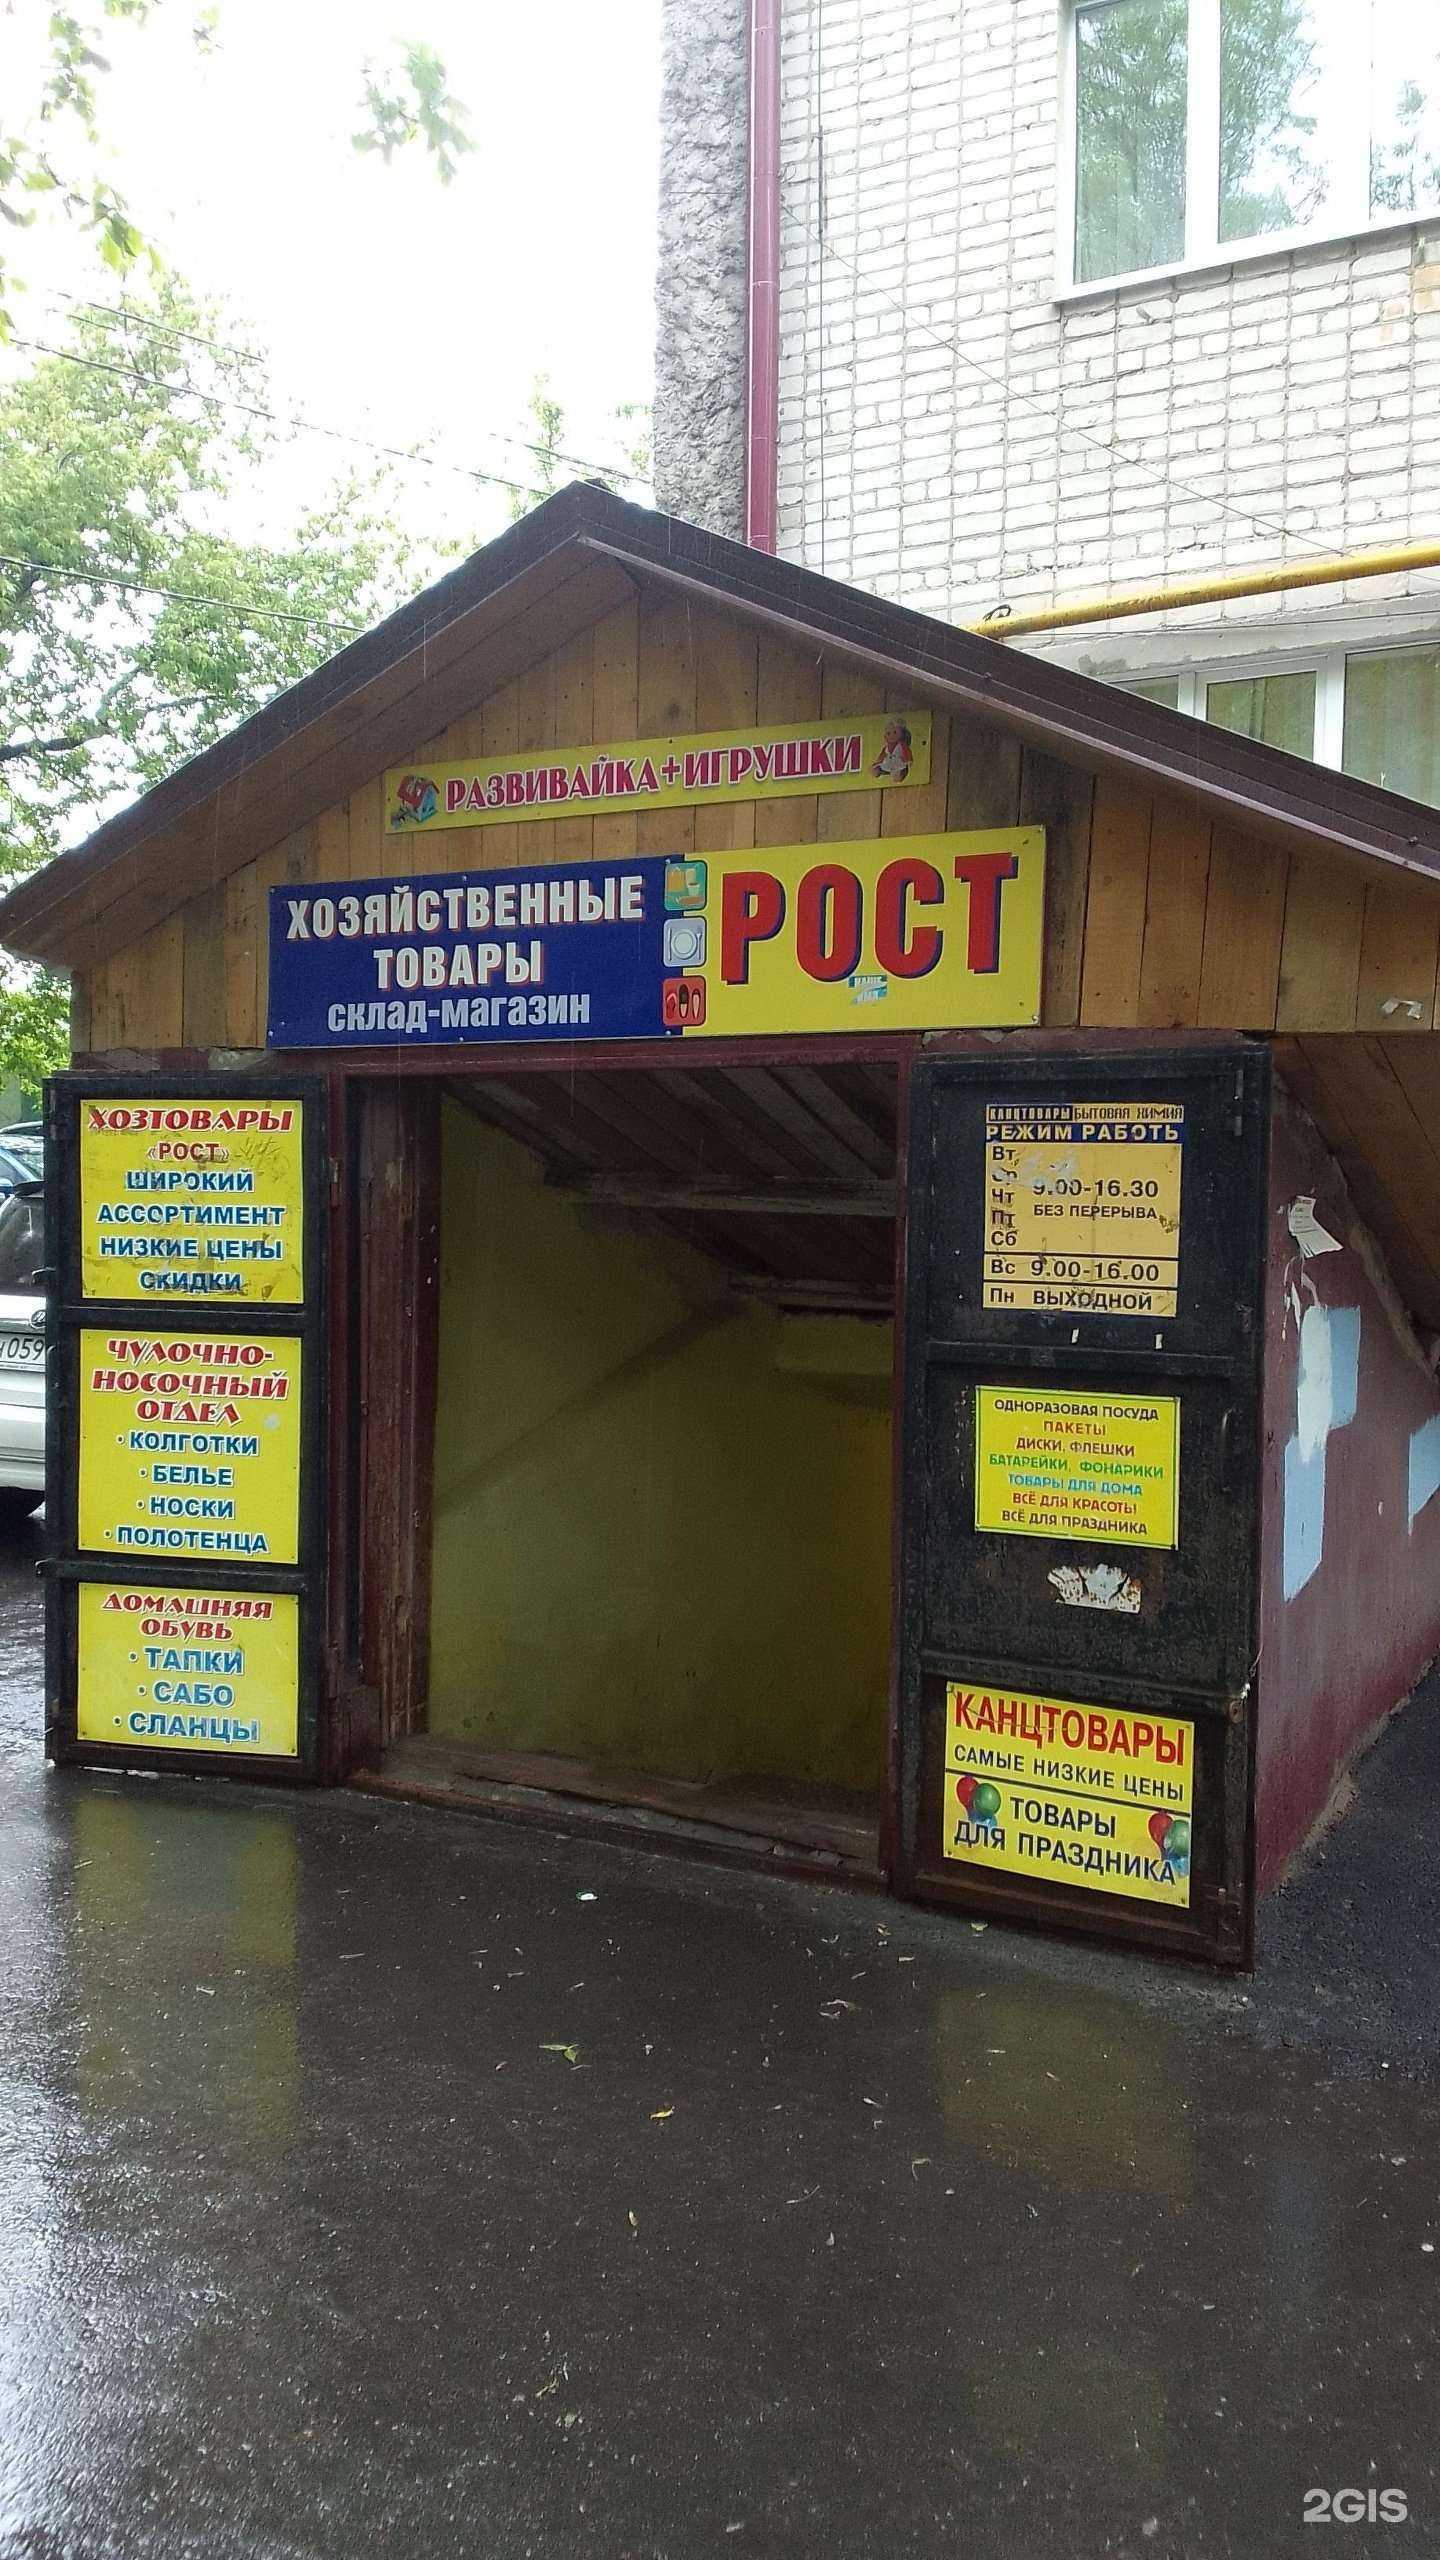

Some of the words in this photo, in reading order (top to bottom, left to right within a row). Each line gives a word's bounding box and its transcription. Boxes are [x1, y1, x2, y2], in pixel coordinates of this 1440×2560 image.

[445, 735, 863, 812] РАЗВИВАЙКА+ИГРУШКИ
[286, 875, 646, 940] ХОЗЯЙСТВЕННЫЕ
[720, 852, 1019, 986] РОСТ
[373, 940, 543, 991] ТОВАРЫ
[327, 994, 590, 1034] склад-магазин
[89, 1109, 293, 1131] ХОЗТОВАРЫ
[1074, 1107, 1130, 1121] БЫТОВАЯ
[1136, 1107, 1183, 1120] ХИМИЯ
[986, 1125, 1072, 1140] РЕЖИМ
[126, 1169, 254, 1191] ШИРОКИЙ
[1032, 1178, 1159, 1198] 9.00-16.30
[97, 1204, 285, 1226] АССОРТИМЕНТ
[1034, 1204, 1064, 1217] БЕЗ
[1070, 1205, 1158, 1220] ПЕРЕРЫВА
[100, 1237, 199, 1257] НИЗКИЕ
[206, 1240, 282, 1261] ЦЕНЫ
[140, 1271, 242, 1293] СКИДКИ
[1031, 1260, 1160, 1281] 9.00-16.00
[1033, 1290, 1153, 1311] ВЫХОДНОЙ
[108, 1339, 273, 1365] ЧУЛОЧНО-
[92, 1370, 289, 1399] НОСОЧНЫЙ
[137, 1400, 240, 1424] ОТДЕЛ
[994, 1398, 1099, 1417] ОДНОРАЗОВАЯ
[1102, 1406, 1160, 1421] ПОСУДА
[1043, 1420, 1107, 1436] ПАКЕТЫ
[129, 1431, 259, 1455] КОЛГОТКИ
[1070, 1441, 1135, 1457] ФЛЕШКИ
[152, 1465, 234, 1486] БЕЛЬЕ
[1080, 1461, 1164, 1478] ФОНАРИКИ
[1008, 1473, 1065, 1489] ТОВАРЫ
[1068, 1478, 1096, 1491] ДЛЯ
[1100, 1480, 1143, 1496] ДОМА
[150, 1497, 235, 1518] НОСКИ
[1012, 1491, 1036, 1505] ВСЁ
[1039, 1495, 1068, 1508] ДЛЯ
[1073, 1498, 1137, 1514] КРАСОТЫ
[1002, 1509, 1025, 1523] ВСЁ
[1029, 1512, 1057, 1526] ДЛЯ
[1061, 1515, 1148, 1535] ПРАЗДНИКА
[117, 1526, 269, 1554] ПОЛОТЕНЦА
[102, 1592, 273, 1619] ДОМАШНЯЯ
[140, 1619, 233, 1643] ОБУВЬ
[144, 1647, 243, 1674] ТАПКИ
[153, 1681, 234, 1707] САБО
[129, 1712, 260, 1743] СЛАНЦЫ
[954, 1691, 1186, 1767] КАНЦТОВАРЫ
[954, 1744, 1025, 1773] САМЫЕ
[1033, 1758, 1115, 1789] НИЗКИЕ
[1124, 1774, 1184, 1802] ЦЕНЫ
[1010, 1796, 1117, 1838] ТОВАРЫ
[954, 1820, 1006, 1851] ДЛЯ
[1018, 1832, 1177, 1886] ПРАЗДНИКА
